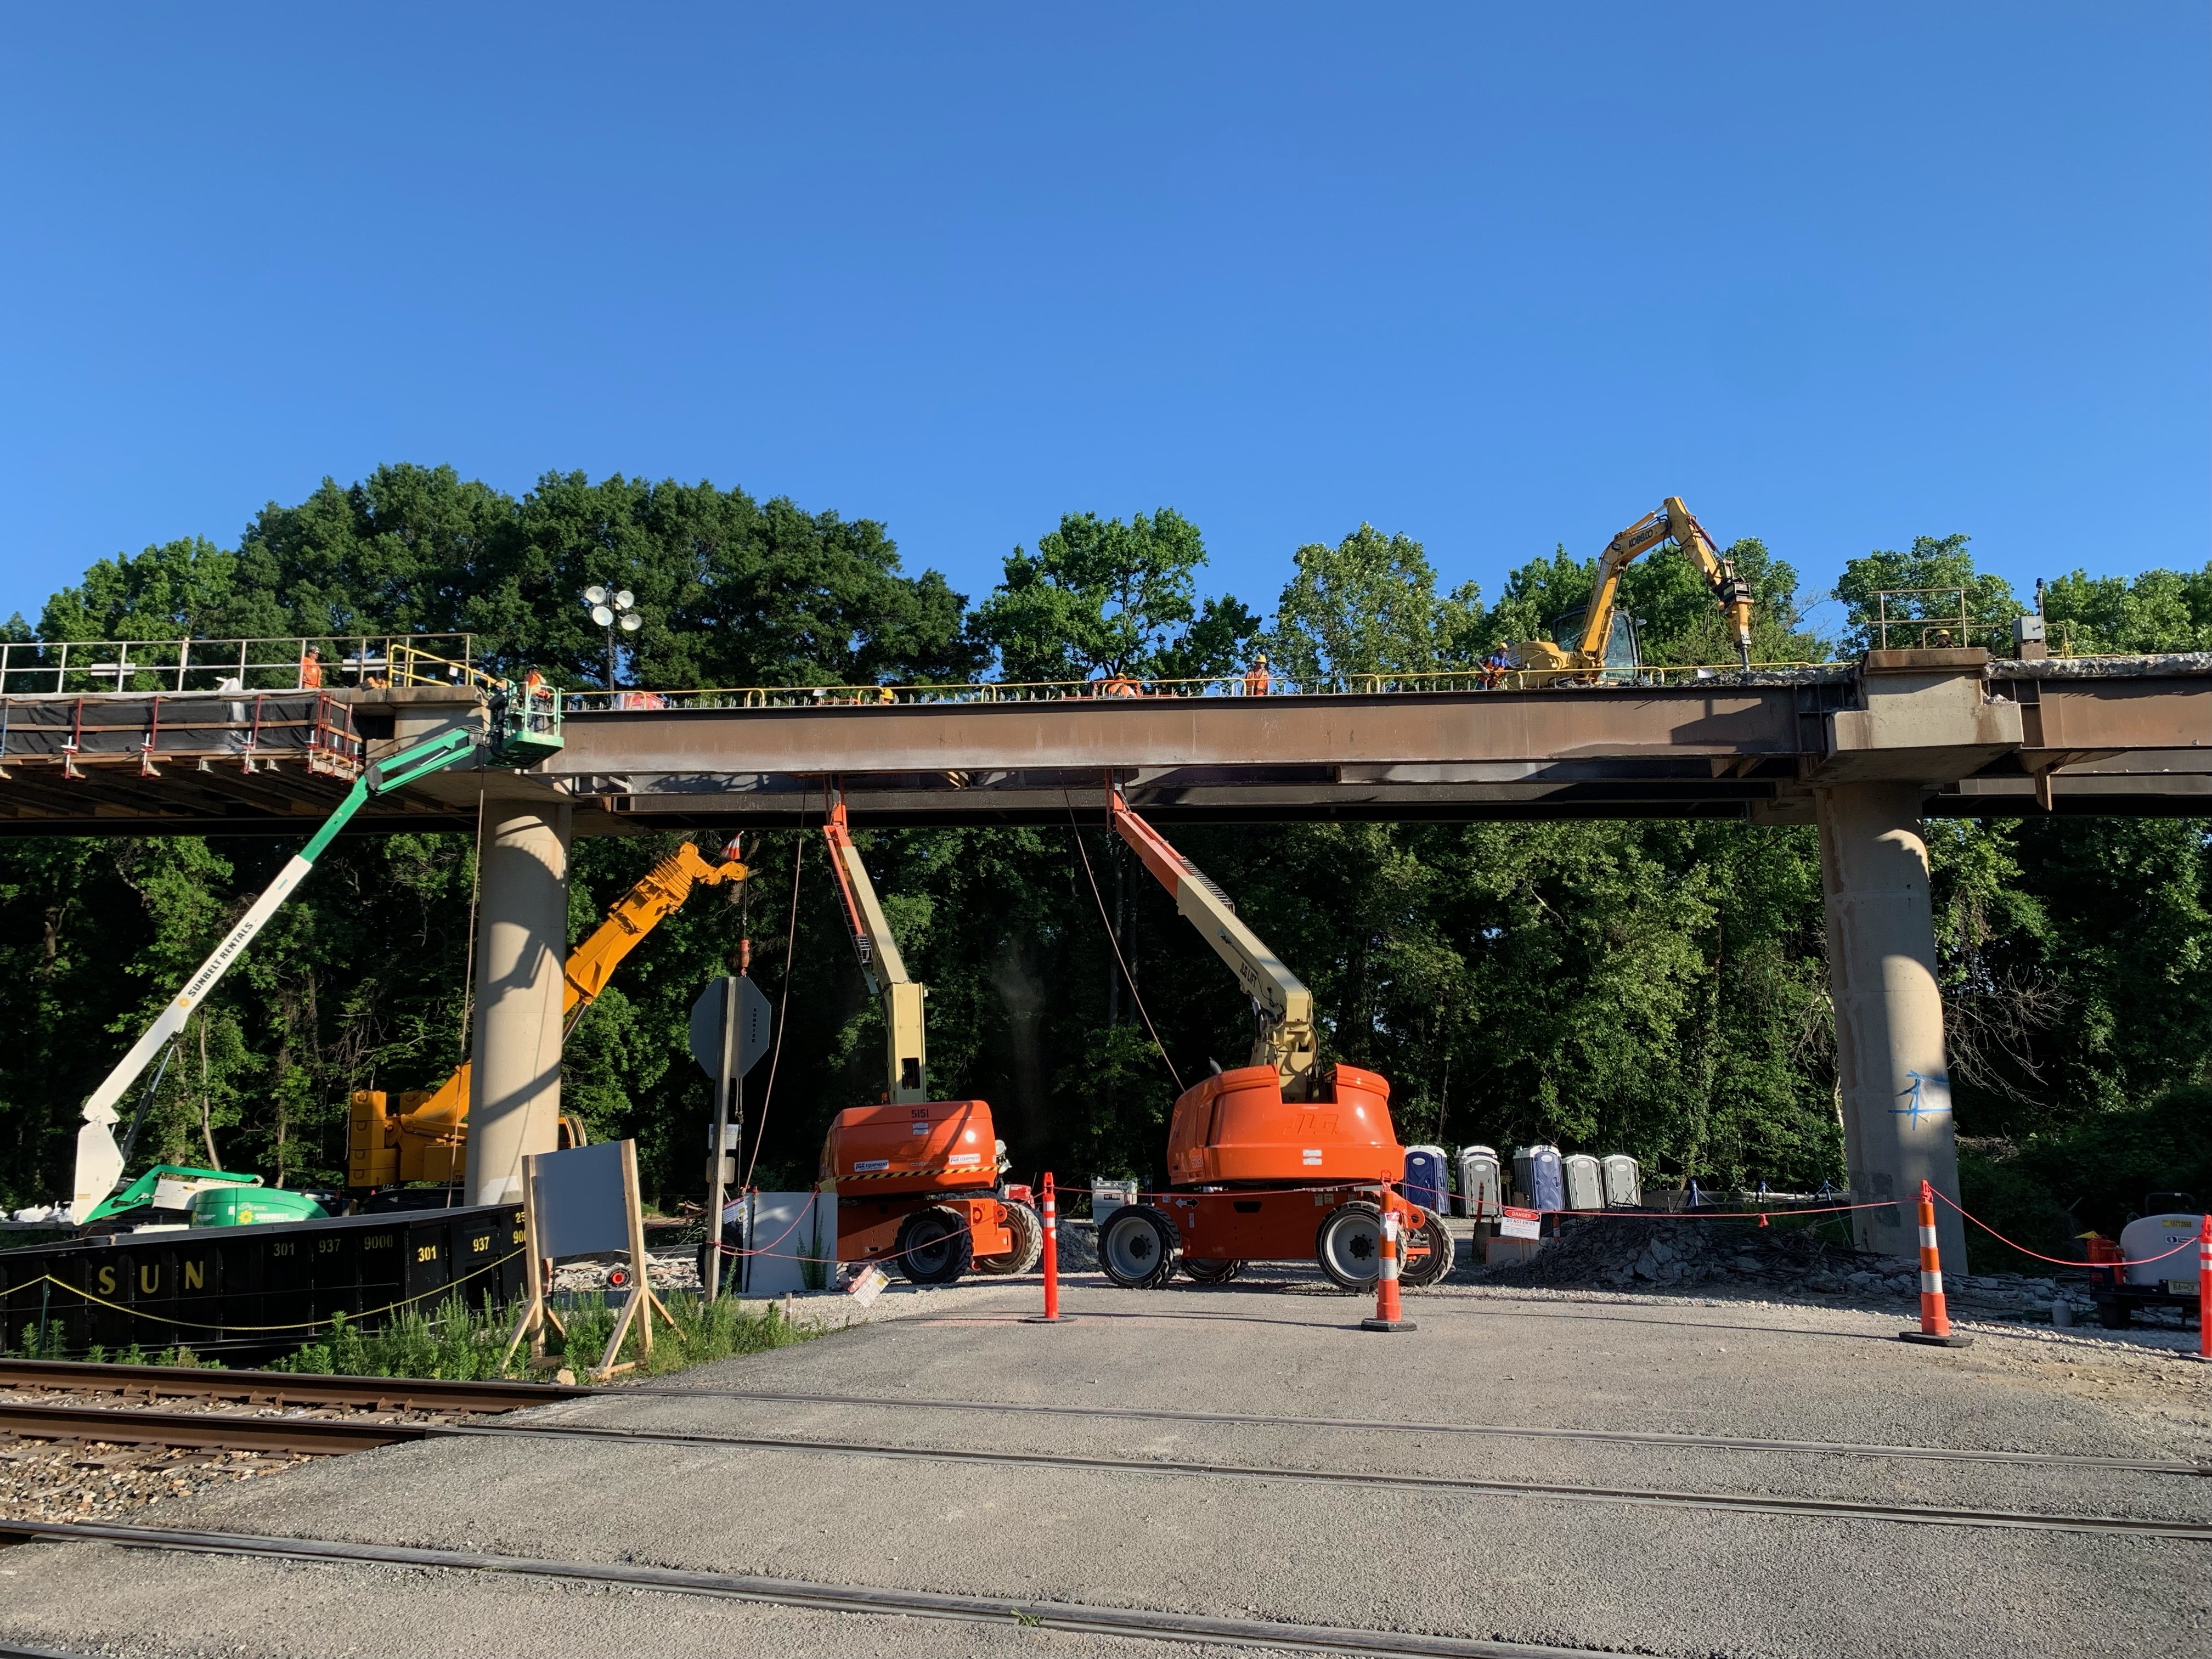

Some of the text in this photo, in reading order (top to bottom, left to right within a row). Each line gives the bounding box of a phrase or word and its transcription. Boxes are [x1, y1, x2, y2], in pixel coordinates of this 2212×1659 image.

[1628, 529, 1653, 549] KOBELCO
[188, 922, 253, 997] SUNBELT RENTALS
[1247, 969, 1257, 988] LIFT
[911, 1109, 929, 1118] 5151
[273, 1234, 393, 1257] 301 937 9000
[417, 1245, 437, 1262] 301
[472, 1236, 490, 1252] 937
[98, 1261, 204, 1295] SUN
